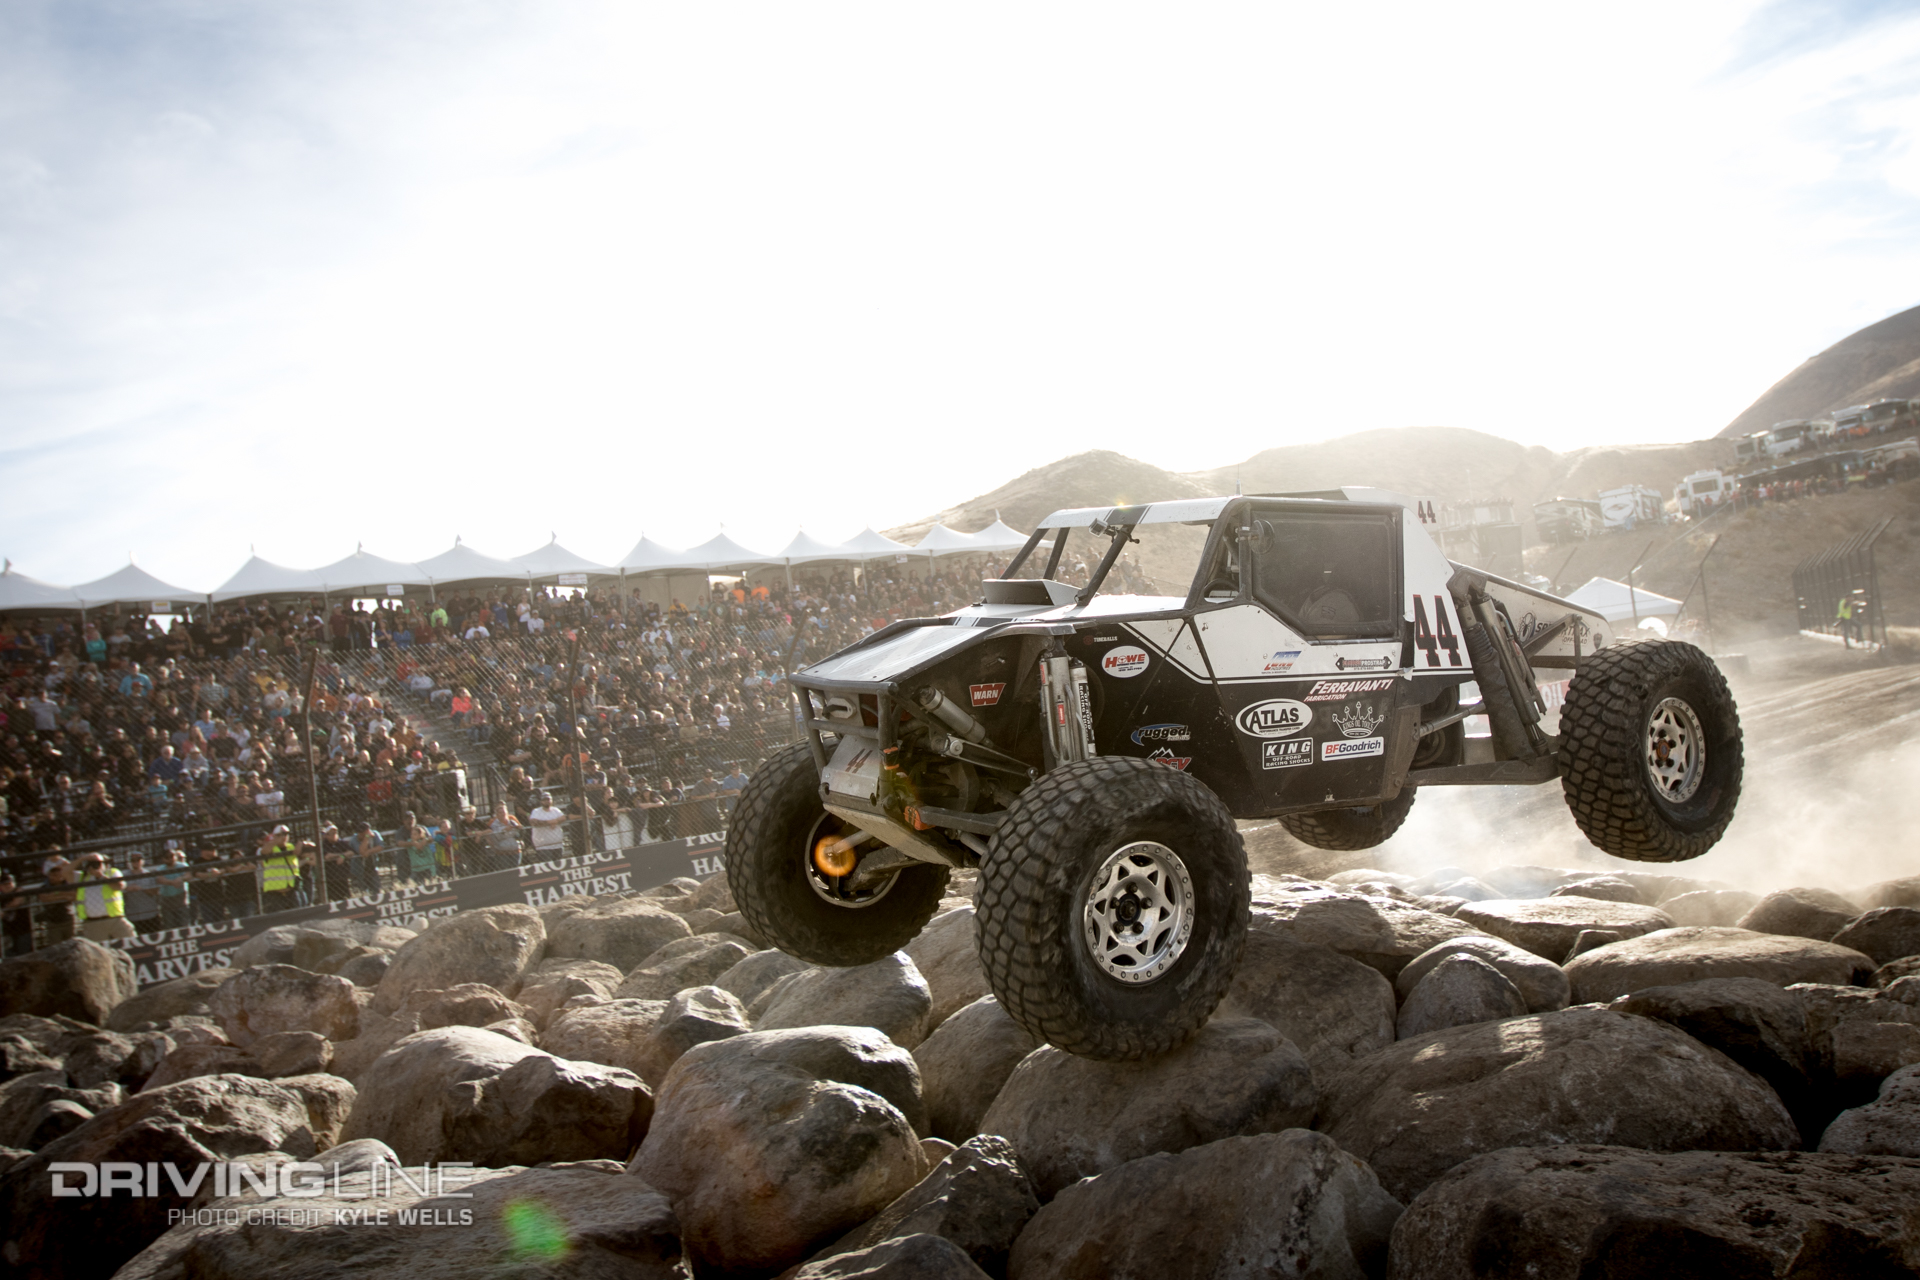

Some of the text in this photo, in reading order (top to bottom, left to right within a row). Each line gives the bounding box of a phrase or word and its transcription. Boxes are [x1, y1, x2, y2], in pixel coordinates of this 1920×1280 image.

[1418, 500, 1436, 523] 44
[1413, 594, 1463, 667] 44
[1104, 653, 1146, 669] HOWE
[973, 689, 999, 700] WARN
[1308, 679, 1395, 695] FERRAVANTI
[1303, 693, 1348, 702] FABRICATION
[1249, 707, 1300, 730] ATLAS
[1266, 741, 1311, 756] KING
[1325, 740, 1381, 755] BFGoodrich
[560, 866, 593, 882] THE
[524, 872, 631, 907] HARVEST
[376, 900, 414, 918] THE
[155, 939, 199, 958] THE
